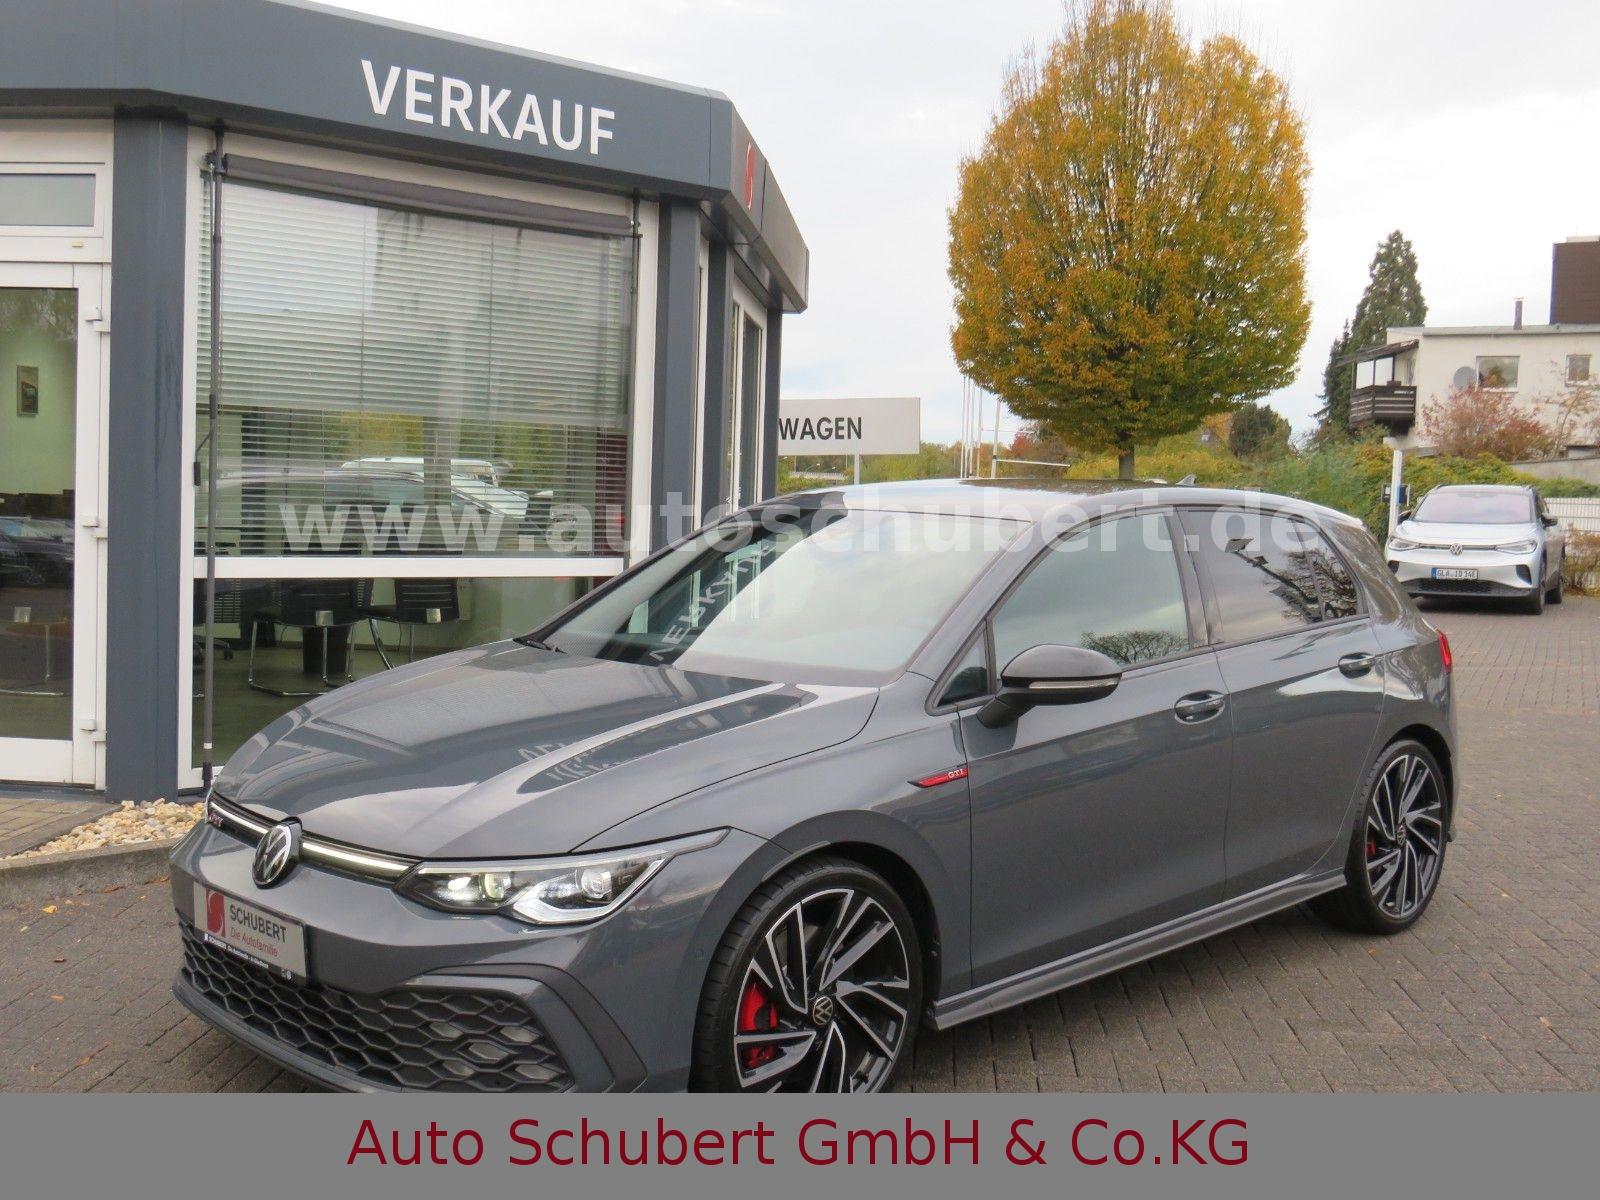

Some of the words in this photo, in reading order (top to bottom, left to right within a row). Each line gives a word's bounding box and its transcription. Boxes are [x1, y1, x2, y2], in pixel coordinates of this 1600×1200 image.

[361, 58, 615, 155] VERKAUF
[948, 769, 964, 779] GTI
[229, 904, 287, 943] SCHUBERT
[231, 927, 241, 938] Die
